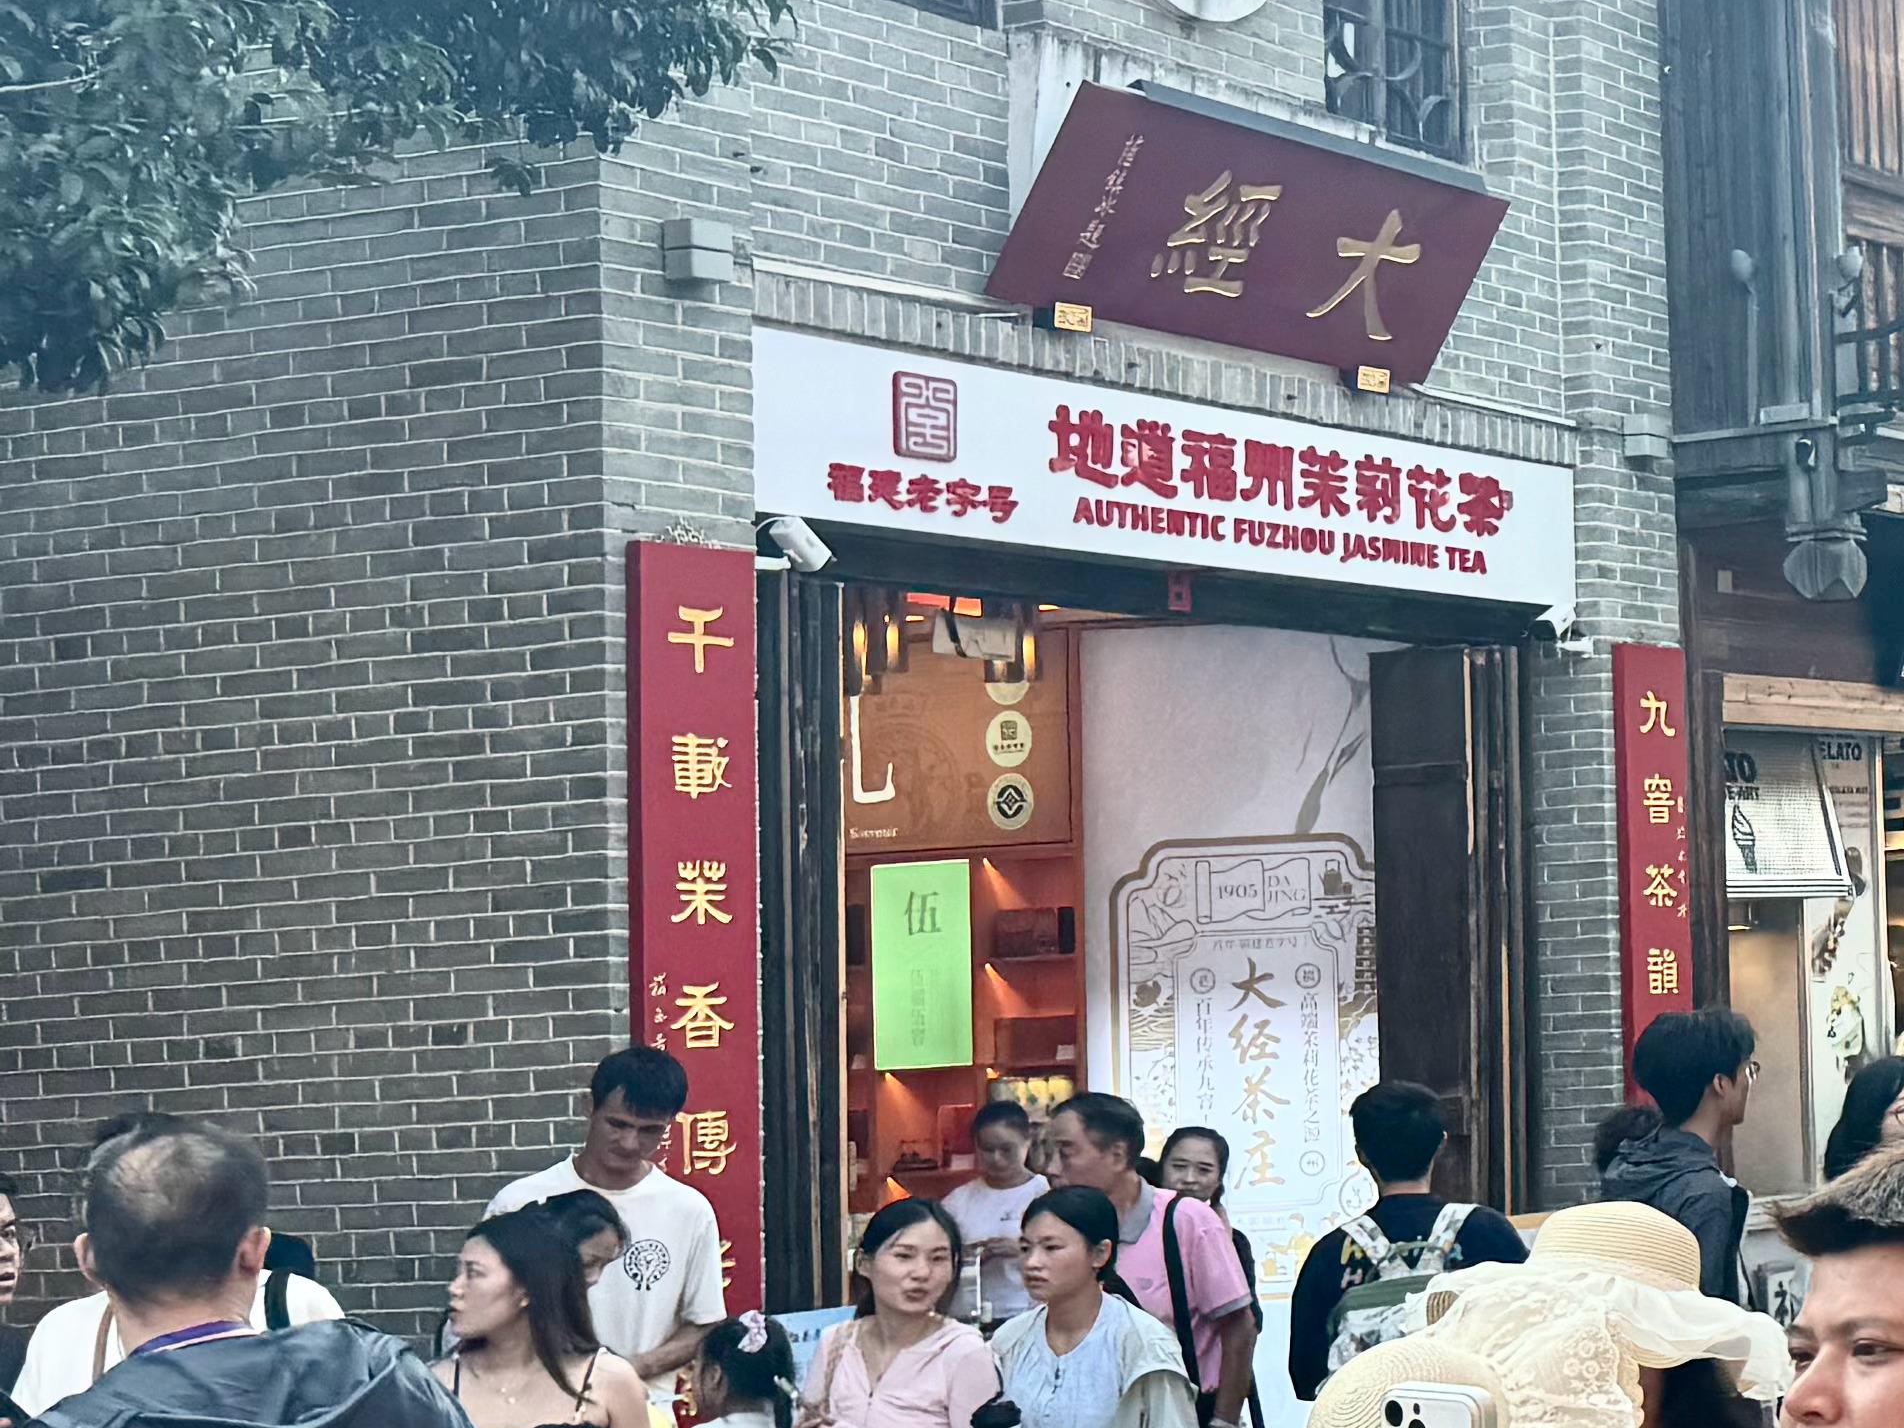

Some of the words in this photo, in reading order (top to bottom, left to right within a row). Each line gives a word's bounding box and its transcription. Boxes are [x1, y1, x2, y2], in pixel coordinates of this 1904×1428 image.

[826, 462, 1019, 524] 福建老字号
[1048, 404, 1512, 537] 地道福州茉莉花茶
[1073, 497, 1226, 542] AUTHENTIC
[1233, 517, 1335, 556] FUZHOU
[1340, 532, 1439, 569] JASMINE
[1445, 546, 1488, 574] TEA
[1819, 741, 1862, 761] ELATO
[1218, 883, 1258, 900] 1905
[667, 604, 737, 1288] 千載茉香傳
[1227, 956, 1291, 1190] 大经茶庄
